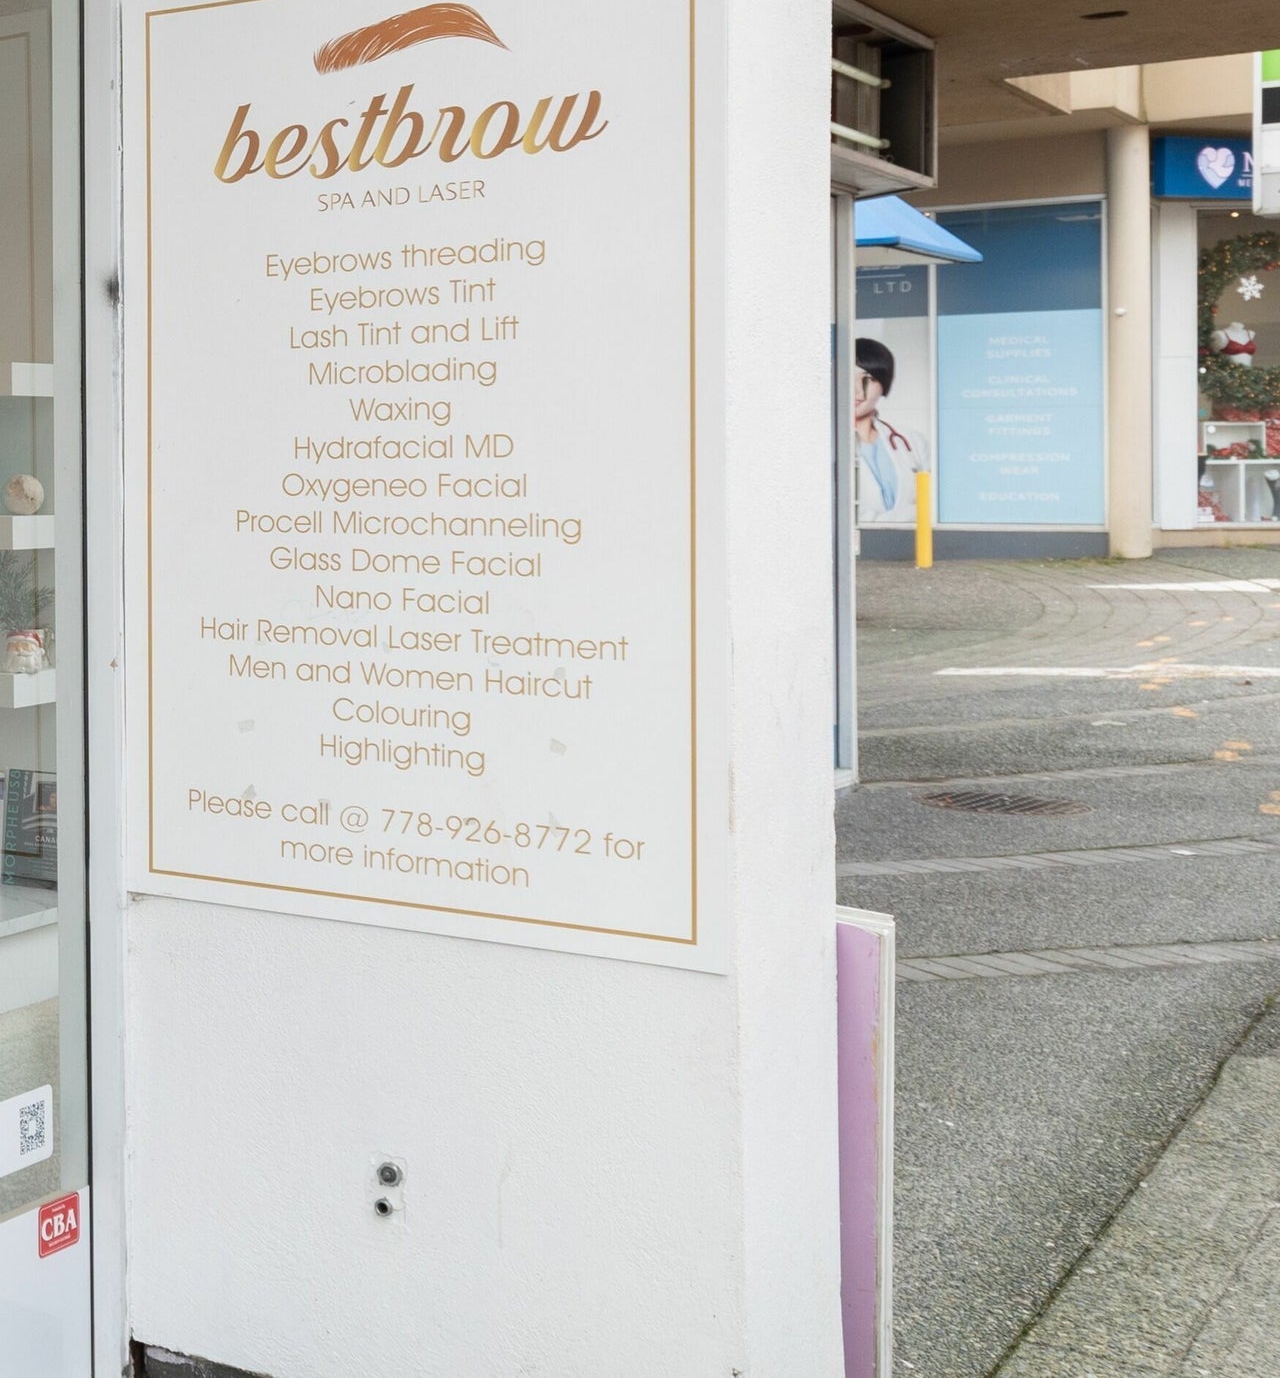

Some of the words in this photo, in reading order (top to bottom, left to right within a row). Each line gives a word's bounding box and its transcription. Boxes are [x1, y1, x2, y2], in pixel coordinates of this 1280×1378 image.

[214, 84, 608, 183] bestbrow
[318, 193, 354, 212] SPA
[361, 187, 410, 208] AND
[418, 180, 486, 203] LASER
[266, 250, 392, 280] Eyebrows
[401, 238, 545, 267] threading
[310, 283, 440, 314] Eyebrows
[450, 278, 496, 303] Tint
[873, 281, 912, 294] LTD
[289, 325, 348, 349] Lash
[358, 322, 402, 347] Tint
[411, 318, 469, 344] and
[480, 316, 518, 341] Lift
[988, 335, 1049, 347] MEDICAL
[985, 349, 1052, 360] SUPPLIES
[308, 358, 498, 386] Microblading
[349, 398, 452, 426] Waxing
[295, 433, 454, 464] Hydrafacial
[464, 434, 513, 459] MD
[281, 473, 427, 502] Oxygeneo
[437, 473, 527, 498] Facial
[236, 509, 323, 535] Procell
[333, 510, 582, 545] Microchanneling
[270, 546, 341, 572] Glass
[352, 549, 440, 575] Dome
[451, 551, 542, 577] Facial
[315, 585, 391, 612] Nano
[402, 588, 490, 615] Facial
[200, 617, 249, 641] Hair
[256, 619, 378, 649] Removal
[388, 625, 461, 652] Laser
[470, 629, 629, 662] Treatment
[228, 654, 286, 680] Men
[295, 660, 351, 684] and
[360, 662, 474, 693] Women
[484, 668, 593, 700] Haircut
[332, 697, 472, 737] Colouring
[319, 734, 486, 777] Highlighting
[2, 769, 22, 885] MORPHEUS8
[188, 789, 272, 820] Please
[281, 801, 329, 827] call
[339, 805, 370, 834] @
[381, 808, 592, 856] 778-926-8772
[603, 832, 645, 861] for
[280, 837, 353, 866] more
[363, 843, 530, 888] information
[41, 1208, 78, 1241] CBA
